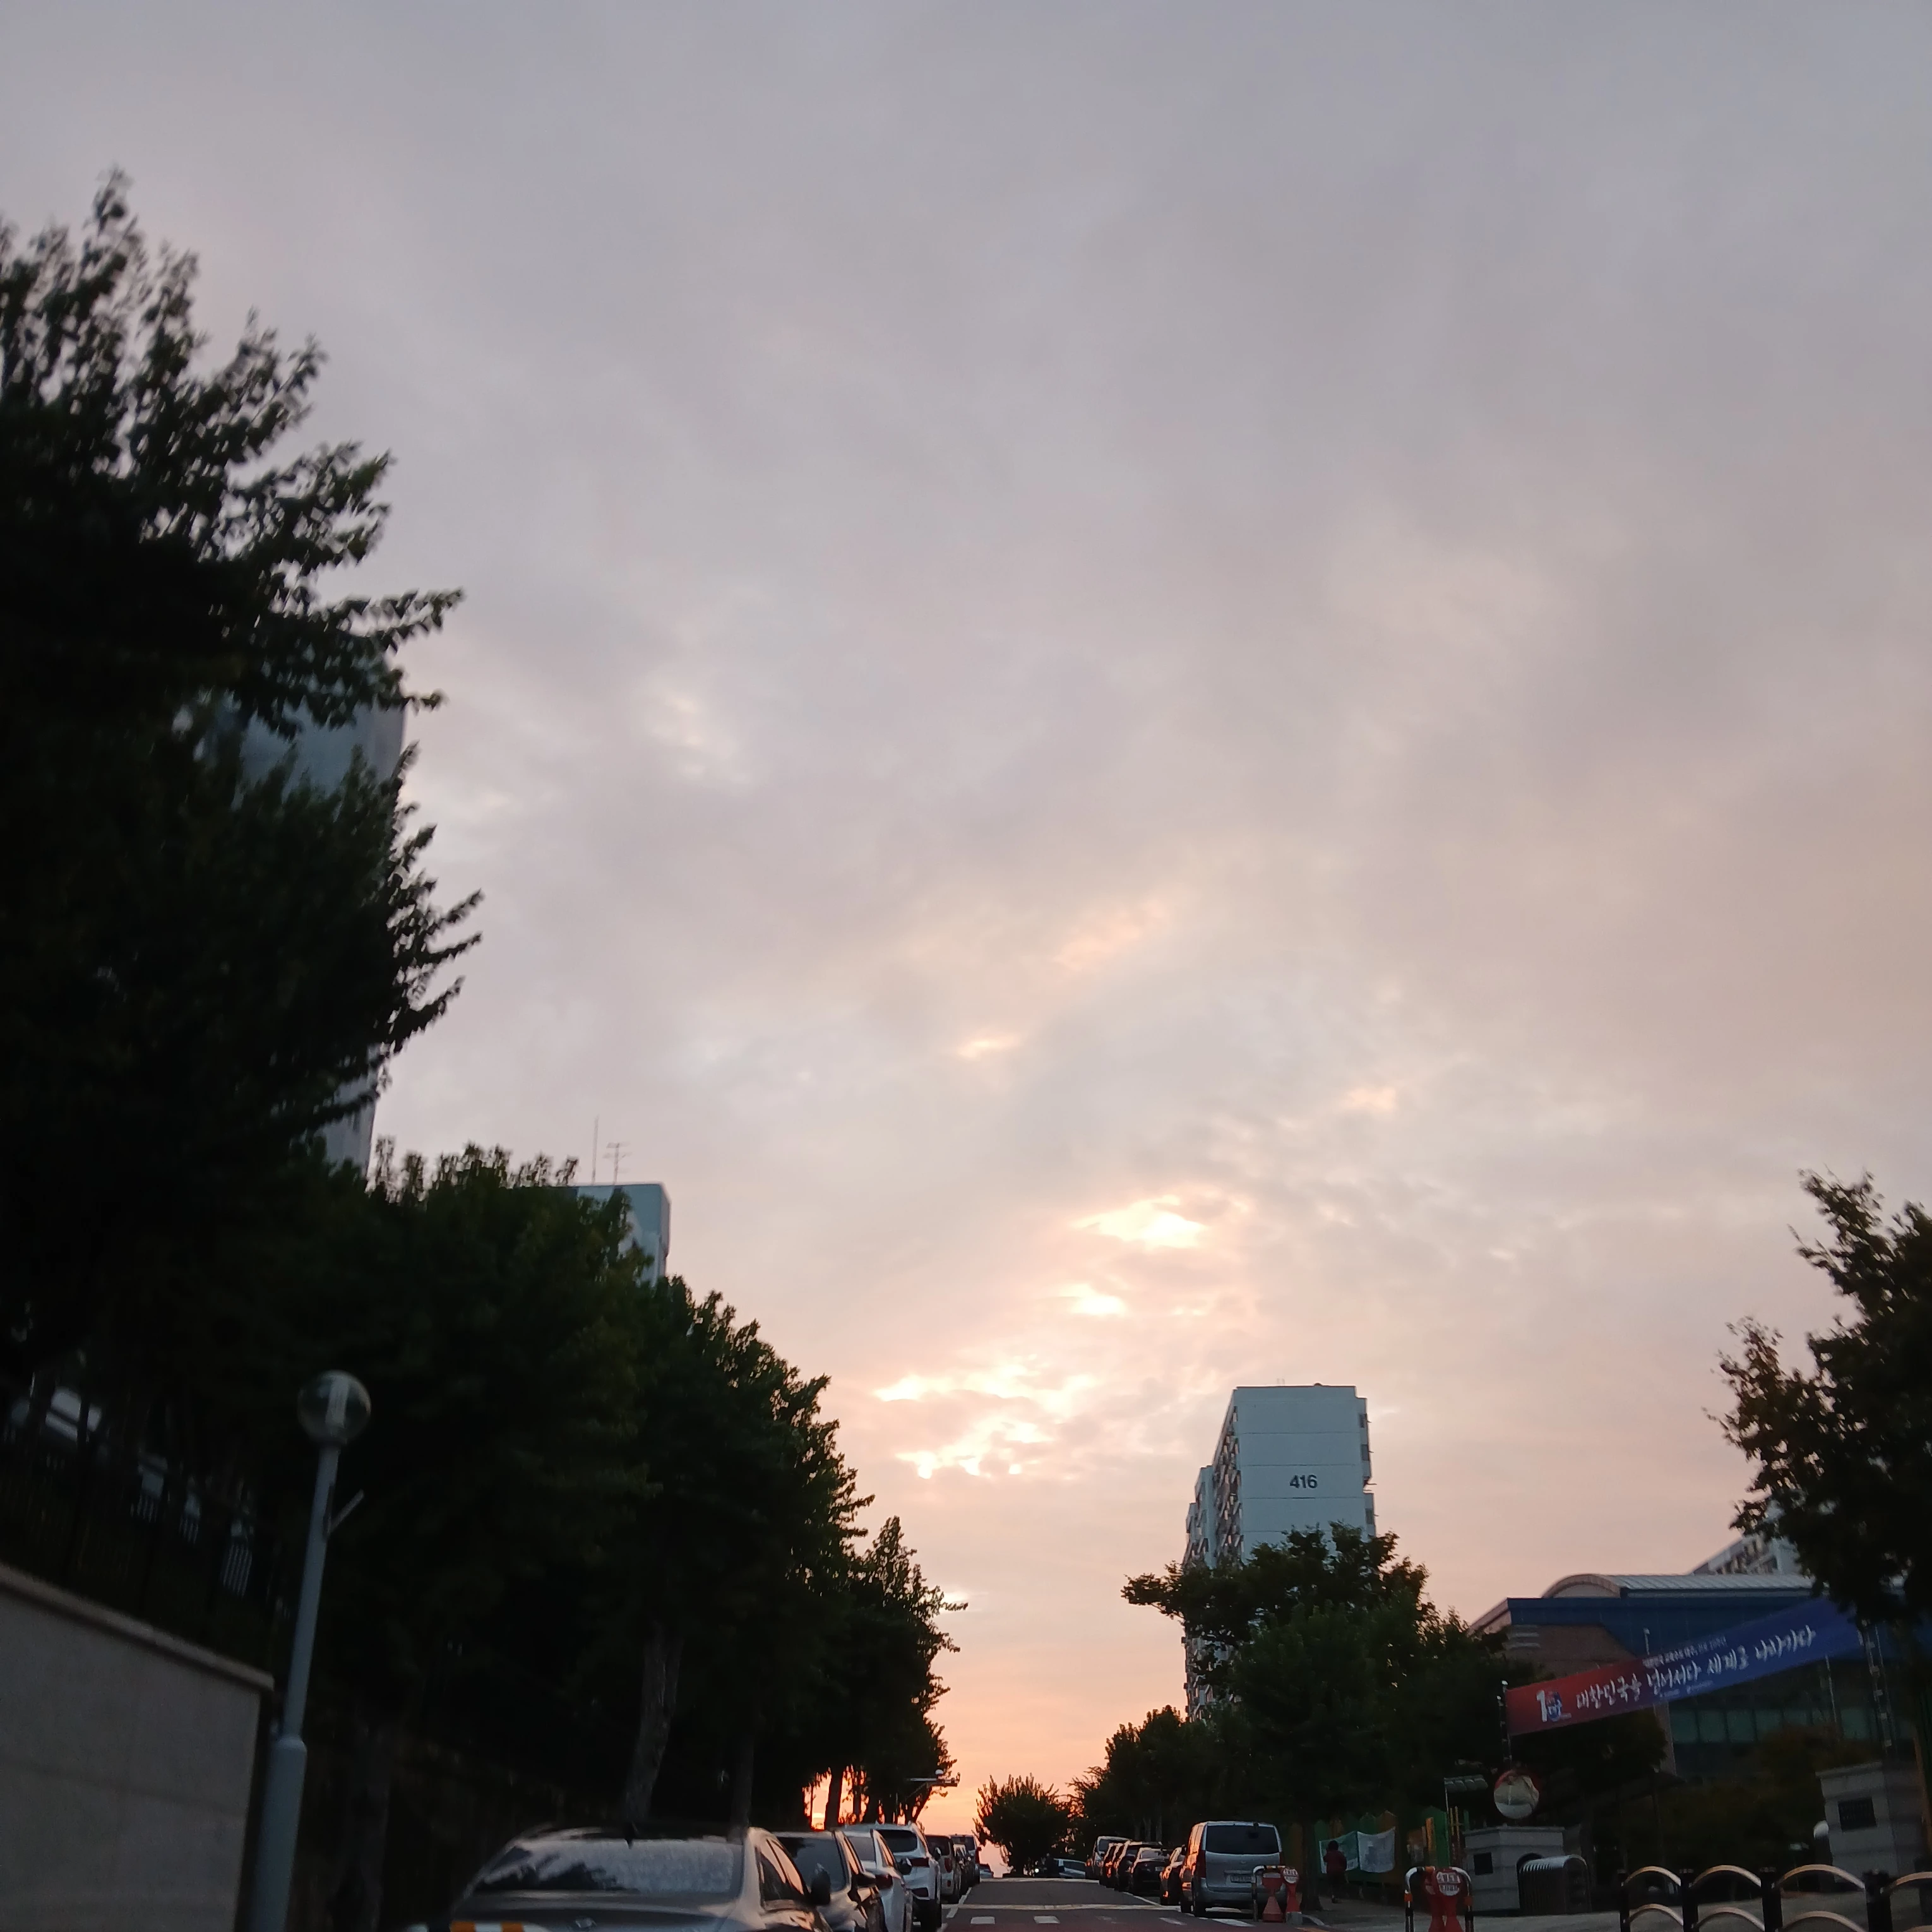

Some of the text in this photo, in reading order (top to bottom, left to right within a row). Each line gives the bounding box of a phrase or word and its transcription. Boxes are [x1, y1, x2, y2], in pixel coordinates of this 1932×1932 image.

[1289, 1474, 1318, 1489] 416
[1576, 1673, 1642, 1709] 대한민국을
[1754, 1624, 1816, 1662] 나아가다
